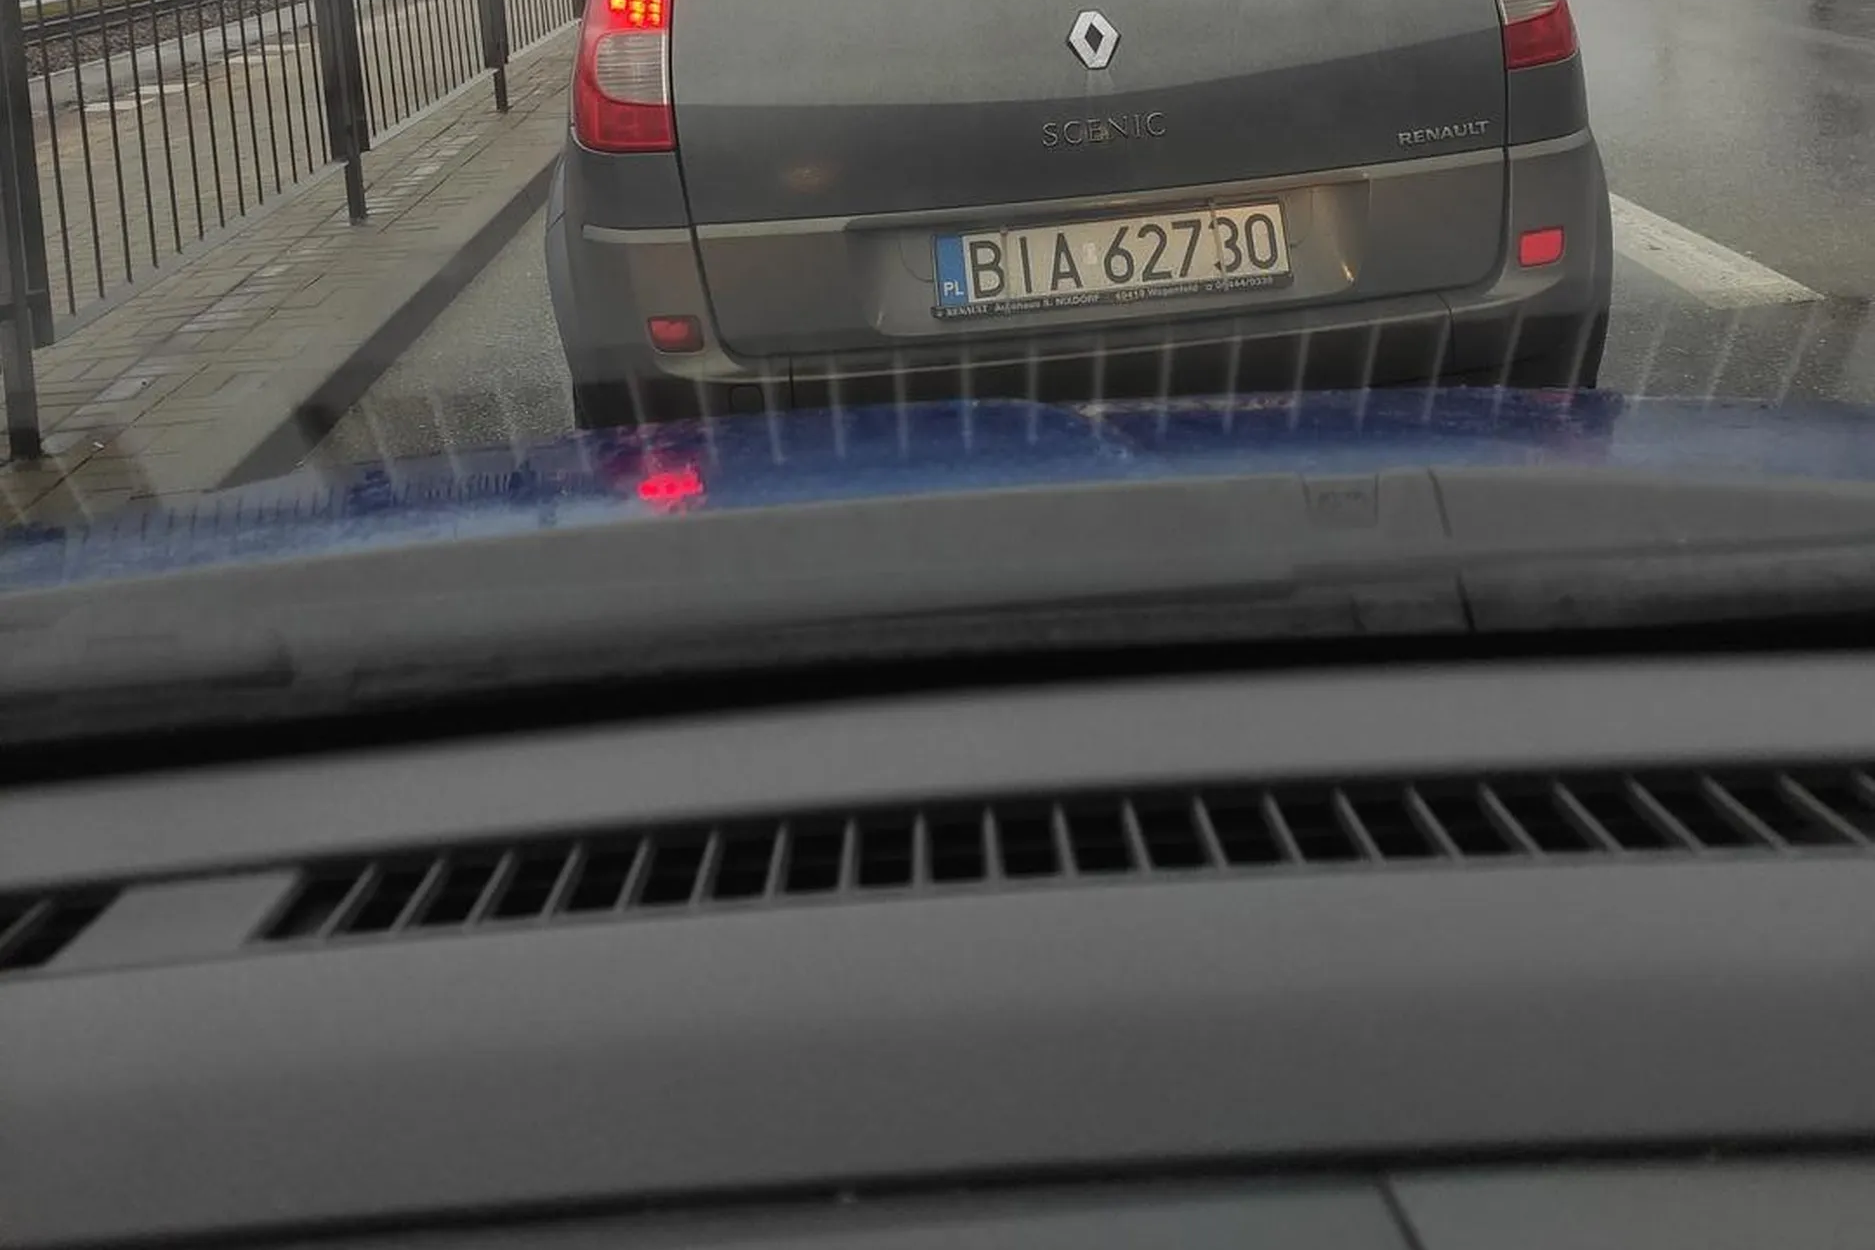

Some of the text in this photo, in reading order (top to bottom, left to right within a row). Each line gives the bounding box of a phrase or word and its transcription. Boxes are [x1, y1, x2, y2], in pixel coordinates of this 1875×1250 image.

[1041, 111, 1167, 147] SCENIC
[1397, 120, 1490, 146] RENAULT
[968, 212, 1279, 300] BIA 62730
[943, 281, 965, 297] PL
